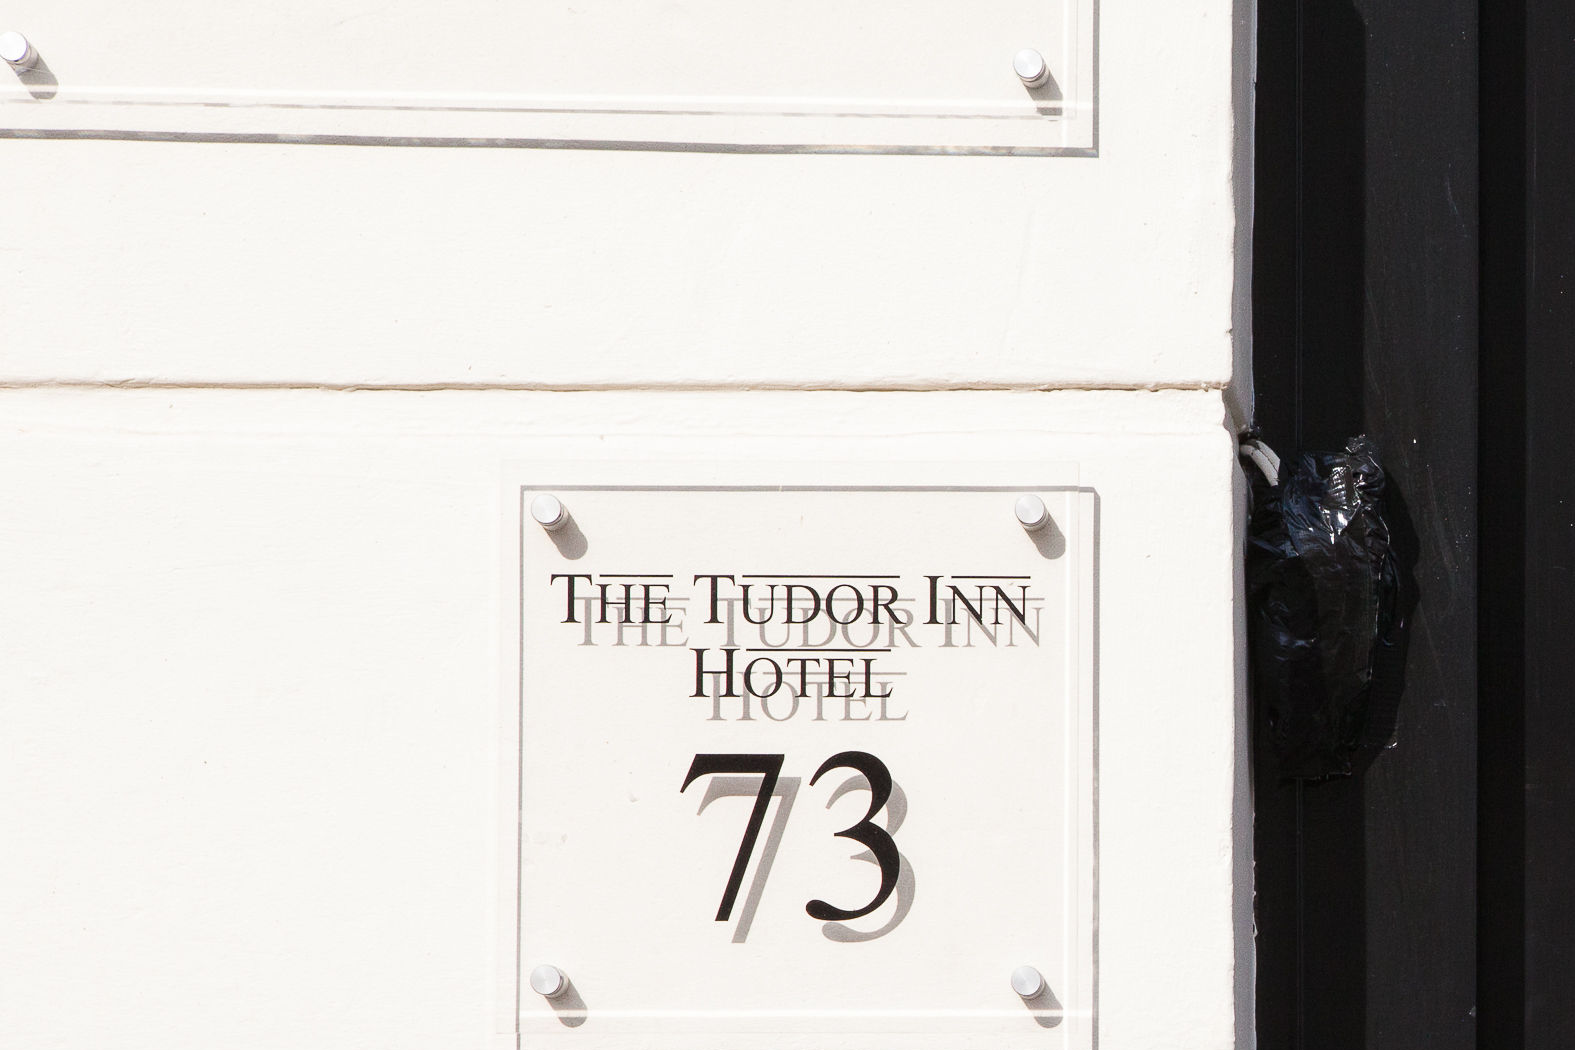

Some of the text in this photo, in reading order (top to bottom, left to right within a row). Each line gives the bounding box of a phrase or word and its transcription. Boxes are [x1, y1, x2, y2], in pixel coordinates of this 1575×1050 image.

[551, 574, 1031, 626] THE TUDOR INN
[689, 648, 893, 699] HOTEL
[680, 750, 901, 922] 73
